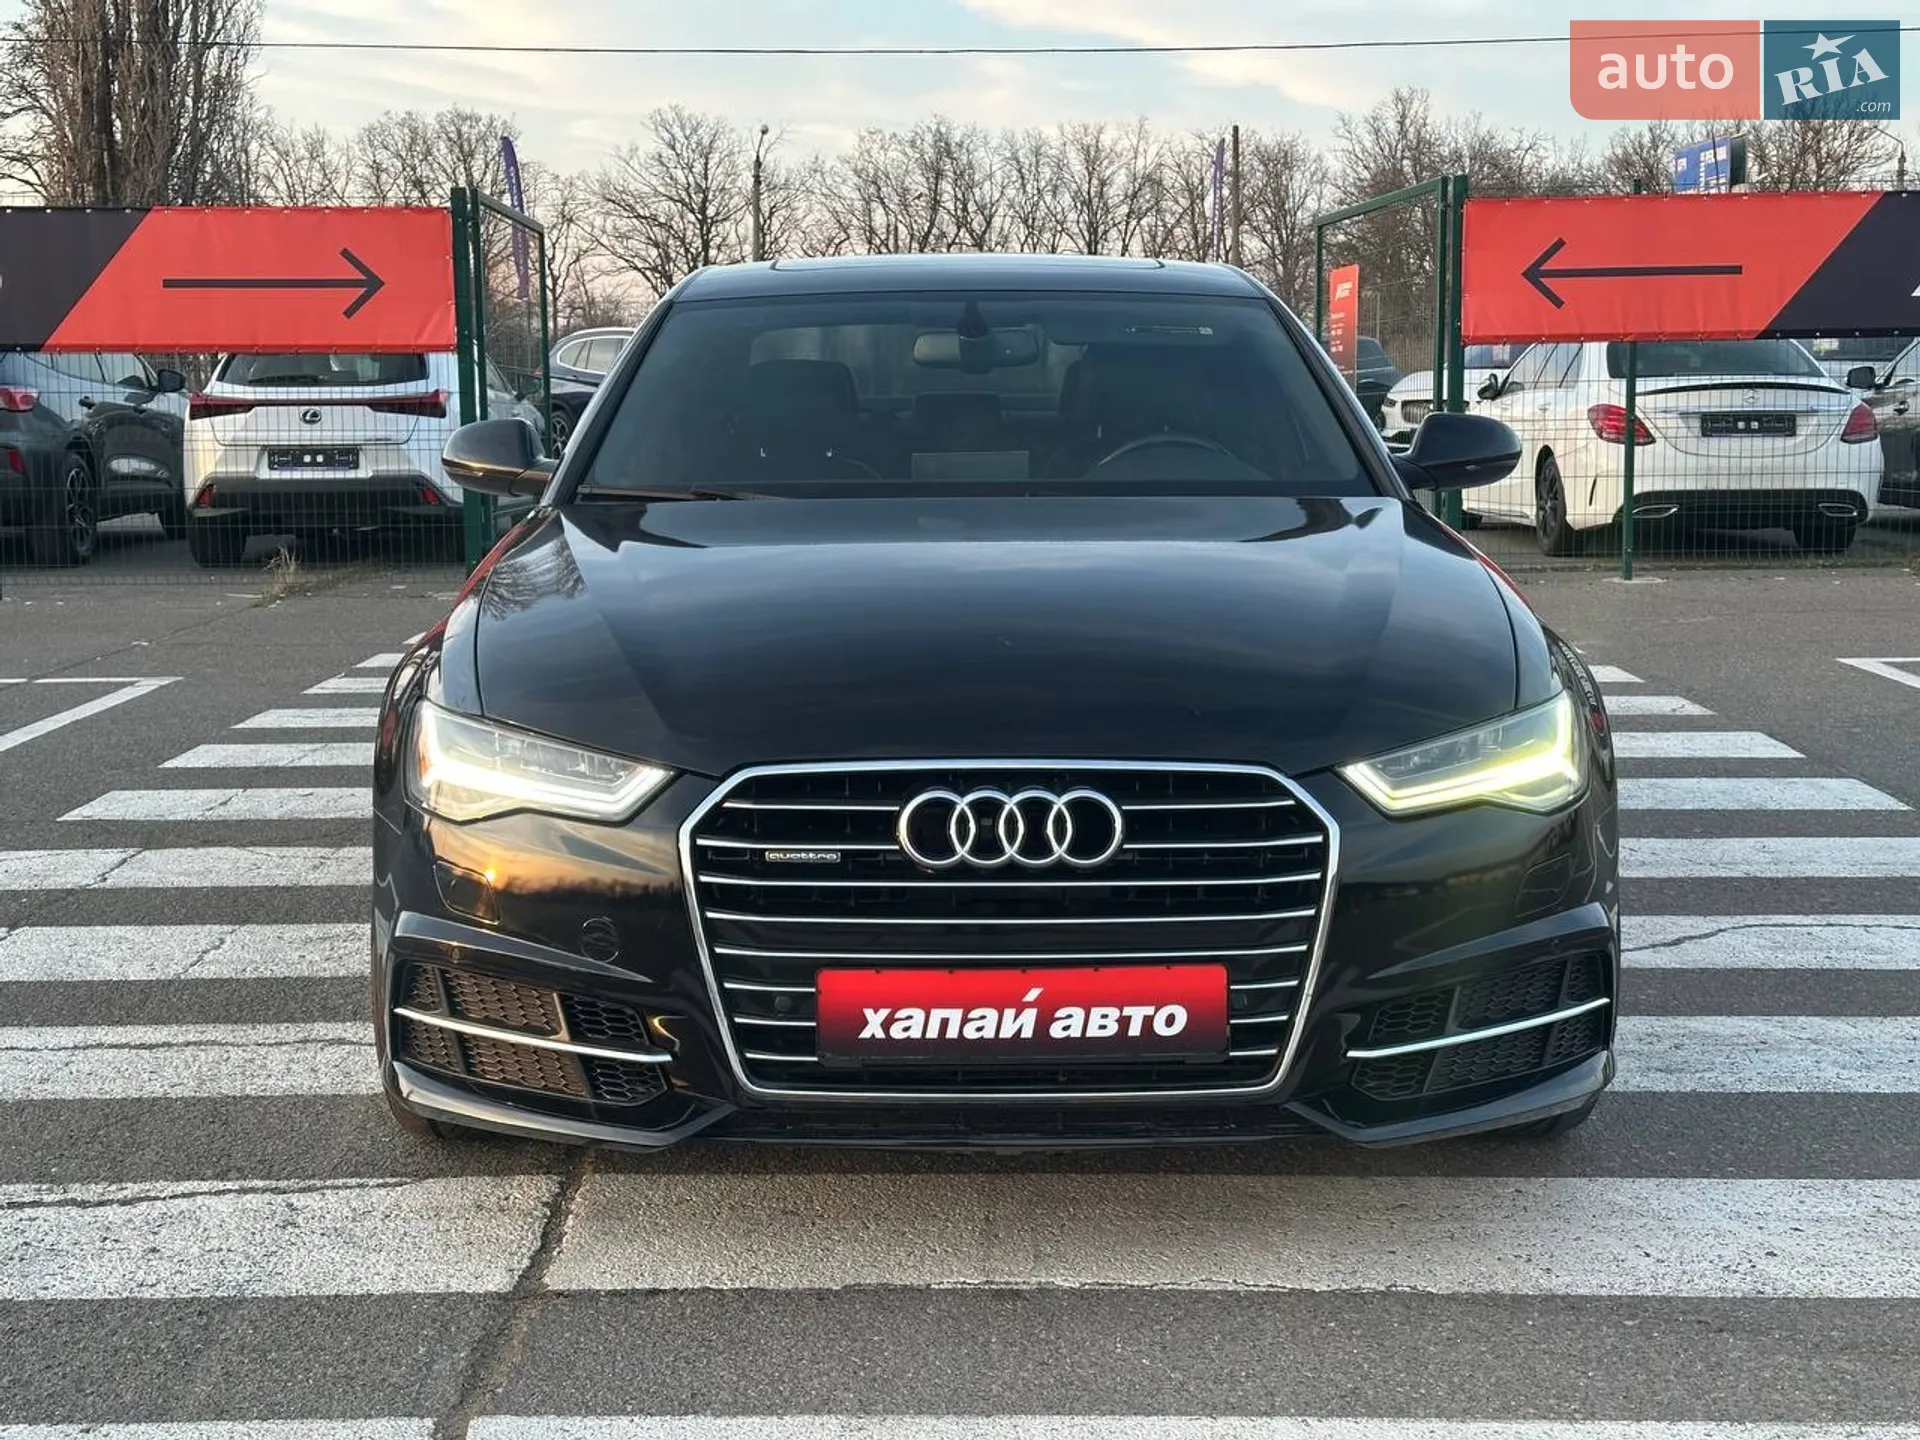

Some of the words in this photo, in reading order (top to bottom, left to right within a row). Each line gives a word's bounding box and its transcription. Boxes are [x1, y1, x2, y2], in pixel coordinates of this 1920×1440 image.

[768, 851, 838, 862] quattro
[857, 986, 1045, 1040] хапай
[1048, 1003, 1189, 1039] авто
